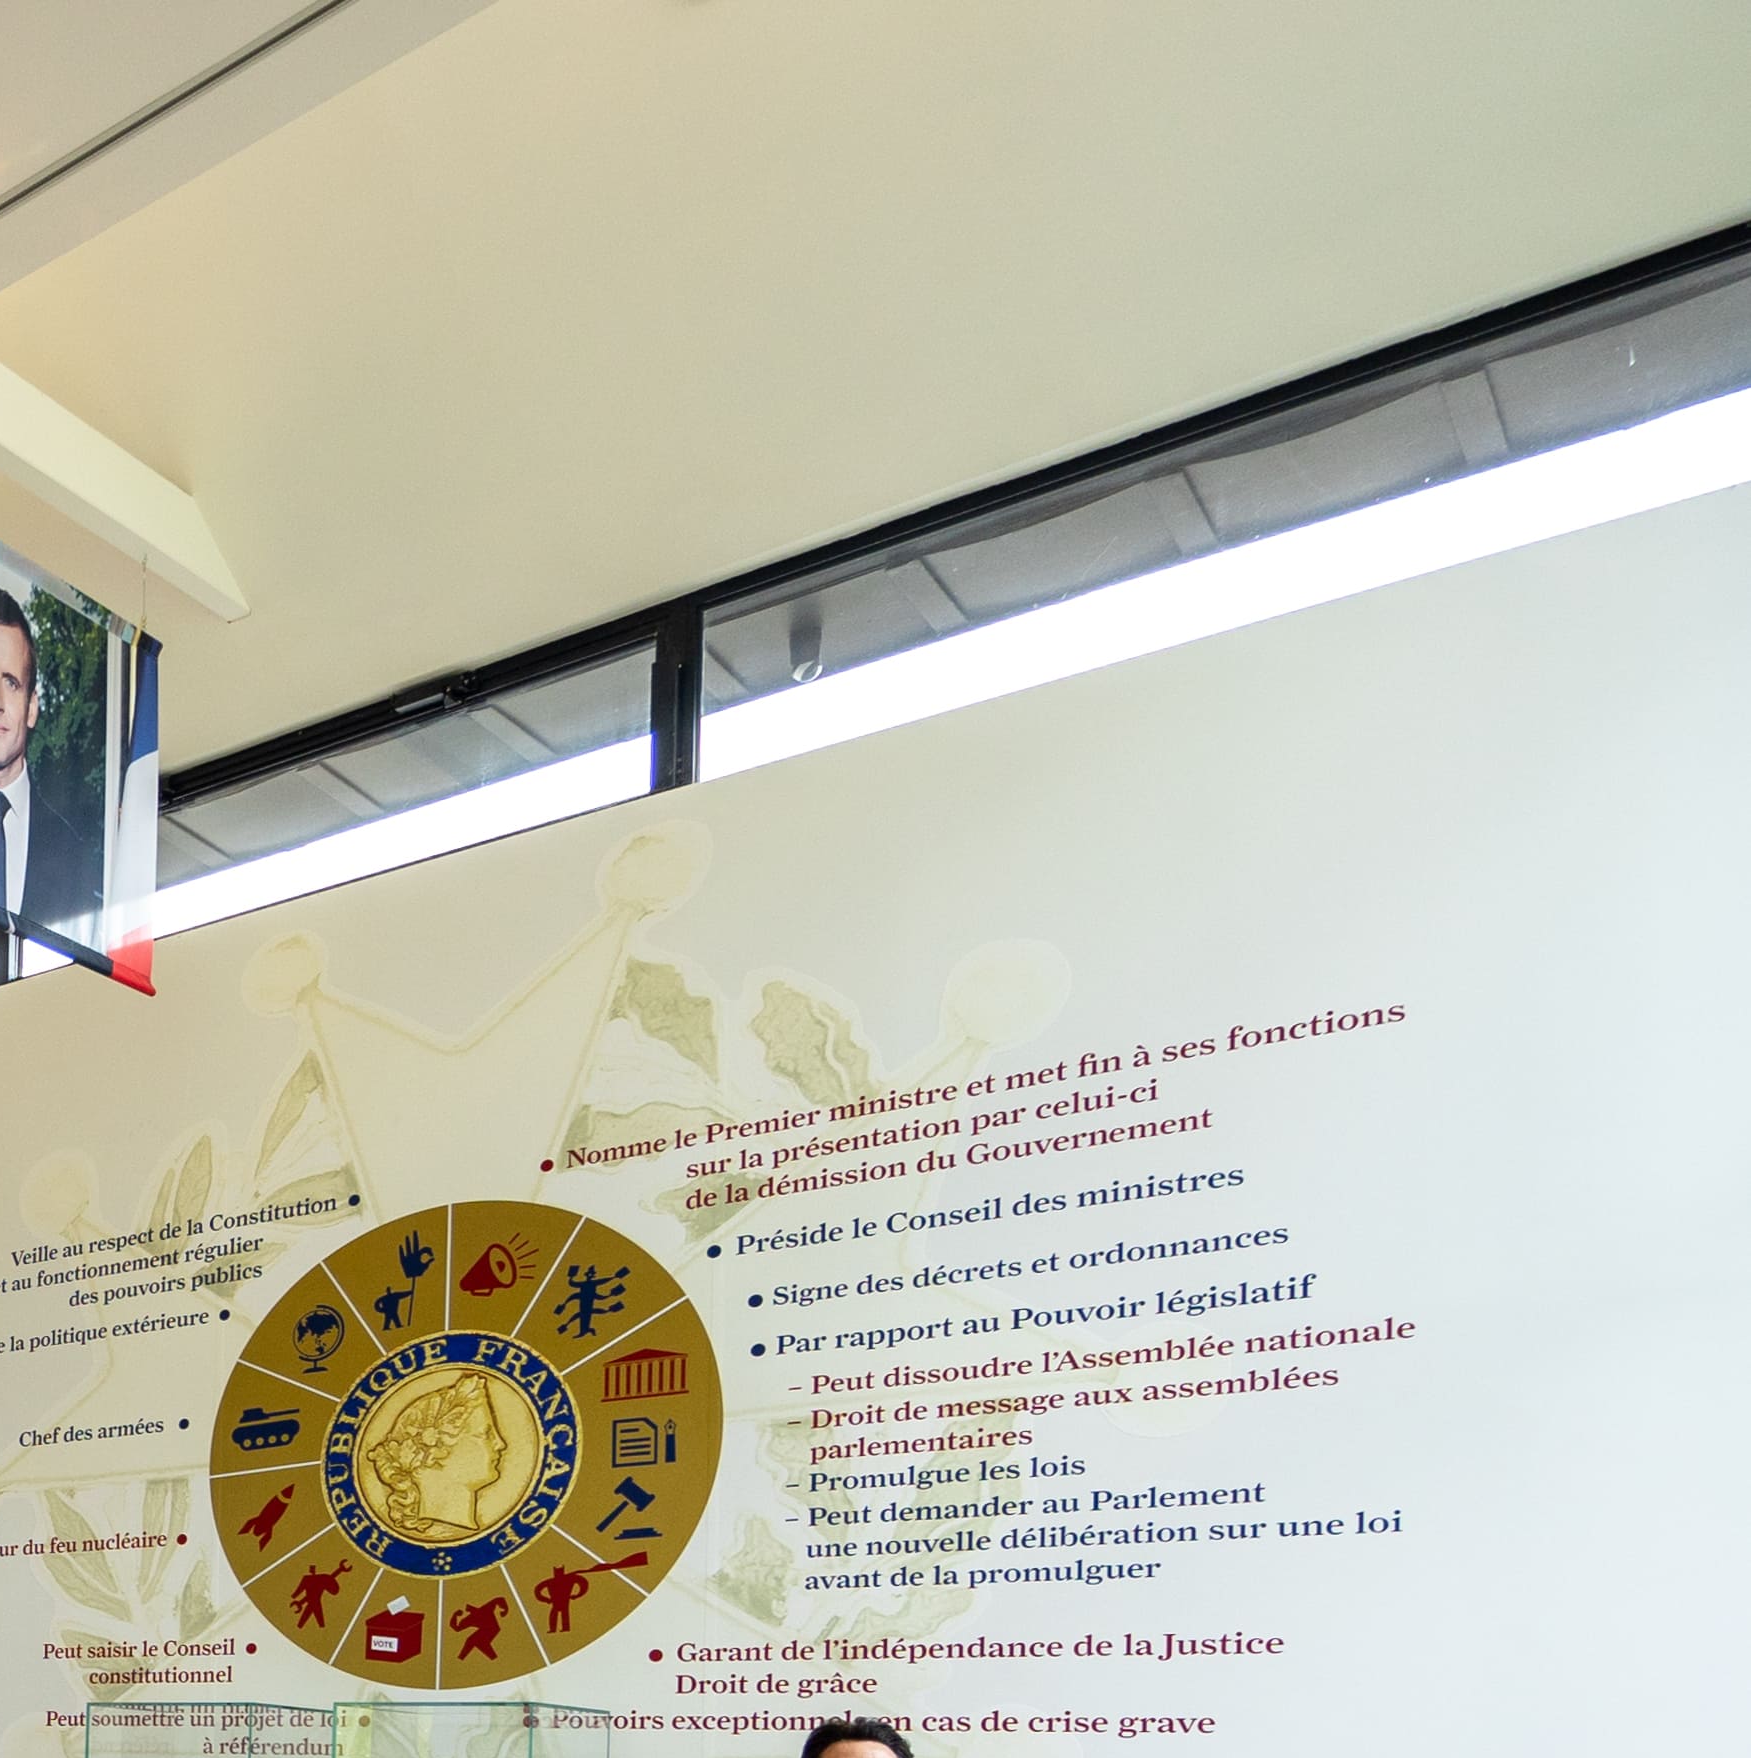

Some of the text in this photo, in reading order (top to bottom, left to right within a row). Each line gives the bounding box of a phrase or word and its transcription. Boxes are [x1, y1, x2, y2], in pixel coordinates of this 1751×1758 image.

[566, 1005, 1405, 1169] Nomme le Premier ministre et met fin à ses fonctions
[686, 1078, 1158, 1178] sur la présentation par celui-ci
[681, 1109, 1213, 1210] de la démission du Gouvernement
[11, 1198, 338, 1266] Veille au respect de la Constitution
[11, 1278, 32, 1291] au
[37, 1250, 179, 1288] fonctionnement
[184, 1236, 265, 1263] régulier
[69, 1263, 263, 1307] des pouvoirs publics
[9, 1336, 25, 1352] la
[29, 1327, 107, 1352] politique
[112, 1312, 209, 1336] extérieure
[776, 1273, 1317, 1355] Par rapport au Pouvoir législatif
[811, 1371, 875, 1395] Peut
[883, 1357, 1033, 1387] dissoudre
[1244, 1317, 1416, 1354] nationale
[811, 1366, 1339, 1433] Droit de message aux assemblées
[19, 1418, 164, 1447] Chef des armées
[809, 1428, 1033, 1466] parlementaires
[808, 1455, 1086, 1492] Promulgue les lois
[808, 1482, 1265, 1527] Peut demander au Parlement
[23, 1539, 45, 1556] du
[49, 1537, 78, 1555] feu
[82, 1531, 167, 1552] nucléaire
[806, 1510, 1403, 1558] une nouvelle délibération sur une loi
[805, 1559, 1161, 1590] avant de la promulguer
[43, 1638, 235, 1659] Peut saisir le Conseil
[373, 1640, 394, 1649] VOTE
[677, 1642, 773, 1662] Garant
[781, 1636, 815, 1661] de
[1073, 1634, 1113, 1657] de
[1123, 1633, 1154, 1656] la
[1157, 1632, 1284, 1661] Justice
[89, 1666, 234, 1685] constitutionnel
[675, 1672, 878, 1699] Droit de grâce
[46, 1710, 346, 1732] Peut soumettre un projet de loi
[552, 1709, 664, 1730] Pouvoirs
[672, 1710, 865, 1735] exceptionnl
[922, 1716, 971, 1732] cas
[981, 1710, 1019, 1732] de
[1028, 1710, 1108, 1733] crise
[1118, 1717, 1216, 1739] grave
[203, 1738, 344, 1757] à référendum
